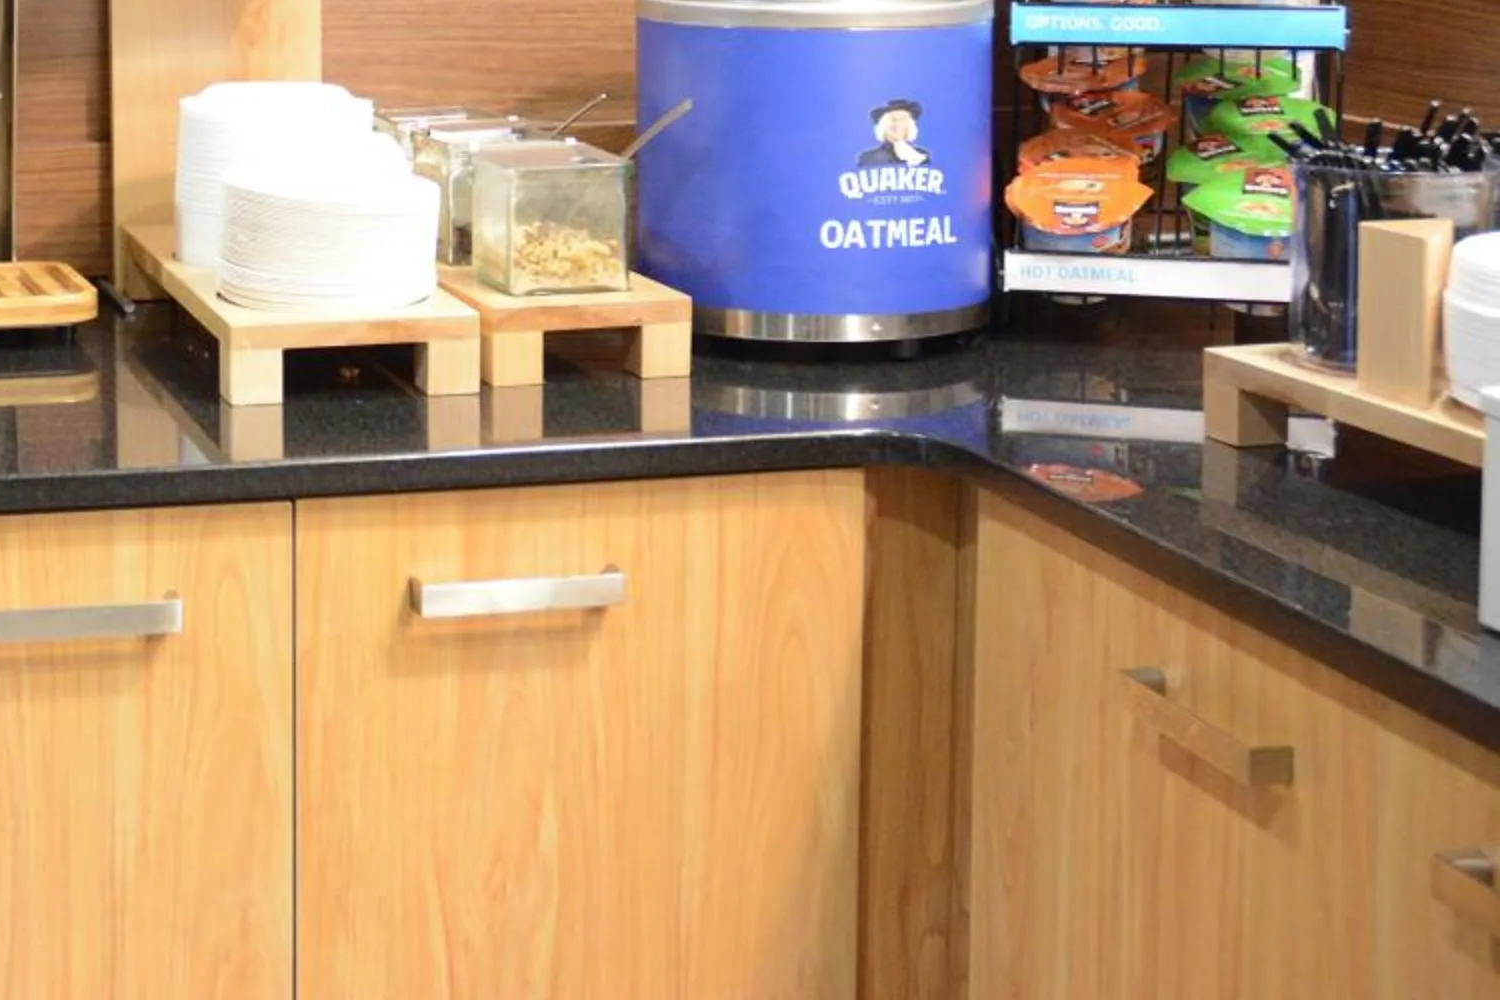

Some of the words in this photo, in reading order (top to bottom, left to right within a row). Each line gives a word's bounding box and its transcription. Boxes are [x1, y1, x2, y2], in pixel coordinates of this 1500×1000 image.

[839, 167, 945, 199] QUAKER
[819, 215, 957, 249] OATMEAL
[1058, 266, 1134, 284] OATMEAL
